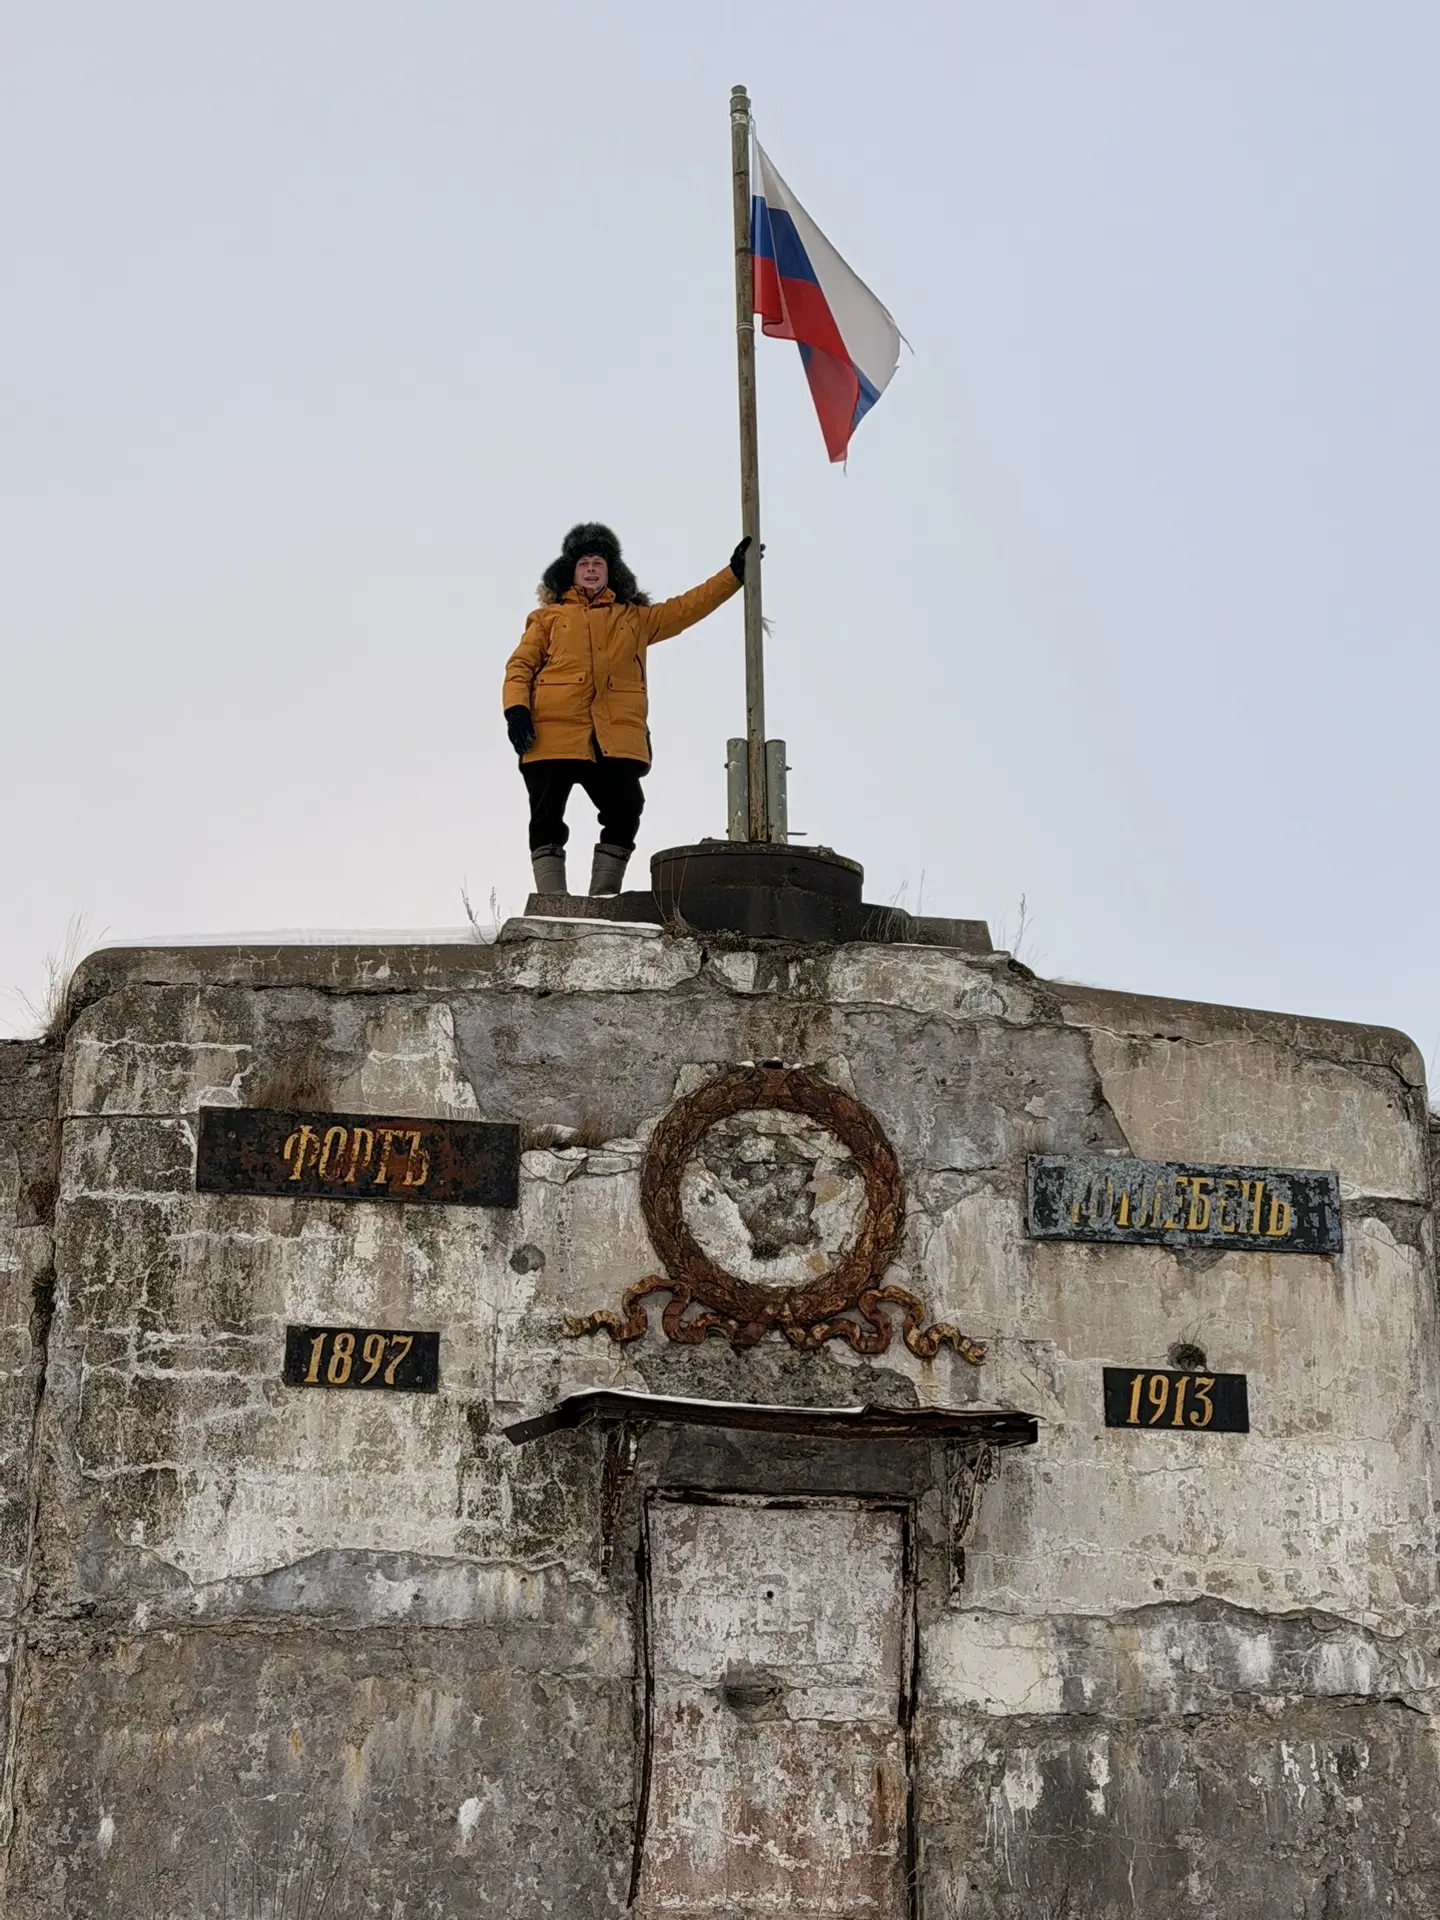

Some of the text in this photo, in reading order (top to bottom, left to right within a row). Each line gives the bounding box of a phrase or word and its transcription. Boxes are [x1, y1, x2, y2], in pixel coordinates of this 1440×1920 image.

[283, 1124, 431, 1186] ФОРТЪ
[303, 1332, 414, 1385] 1897
[1126, 1374, 1216, 1427] 1913
